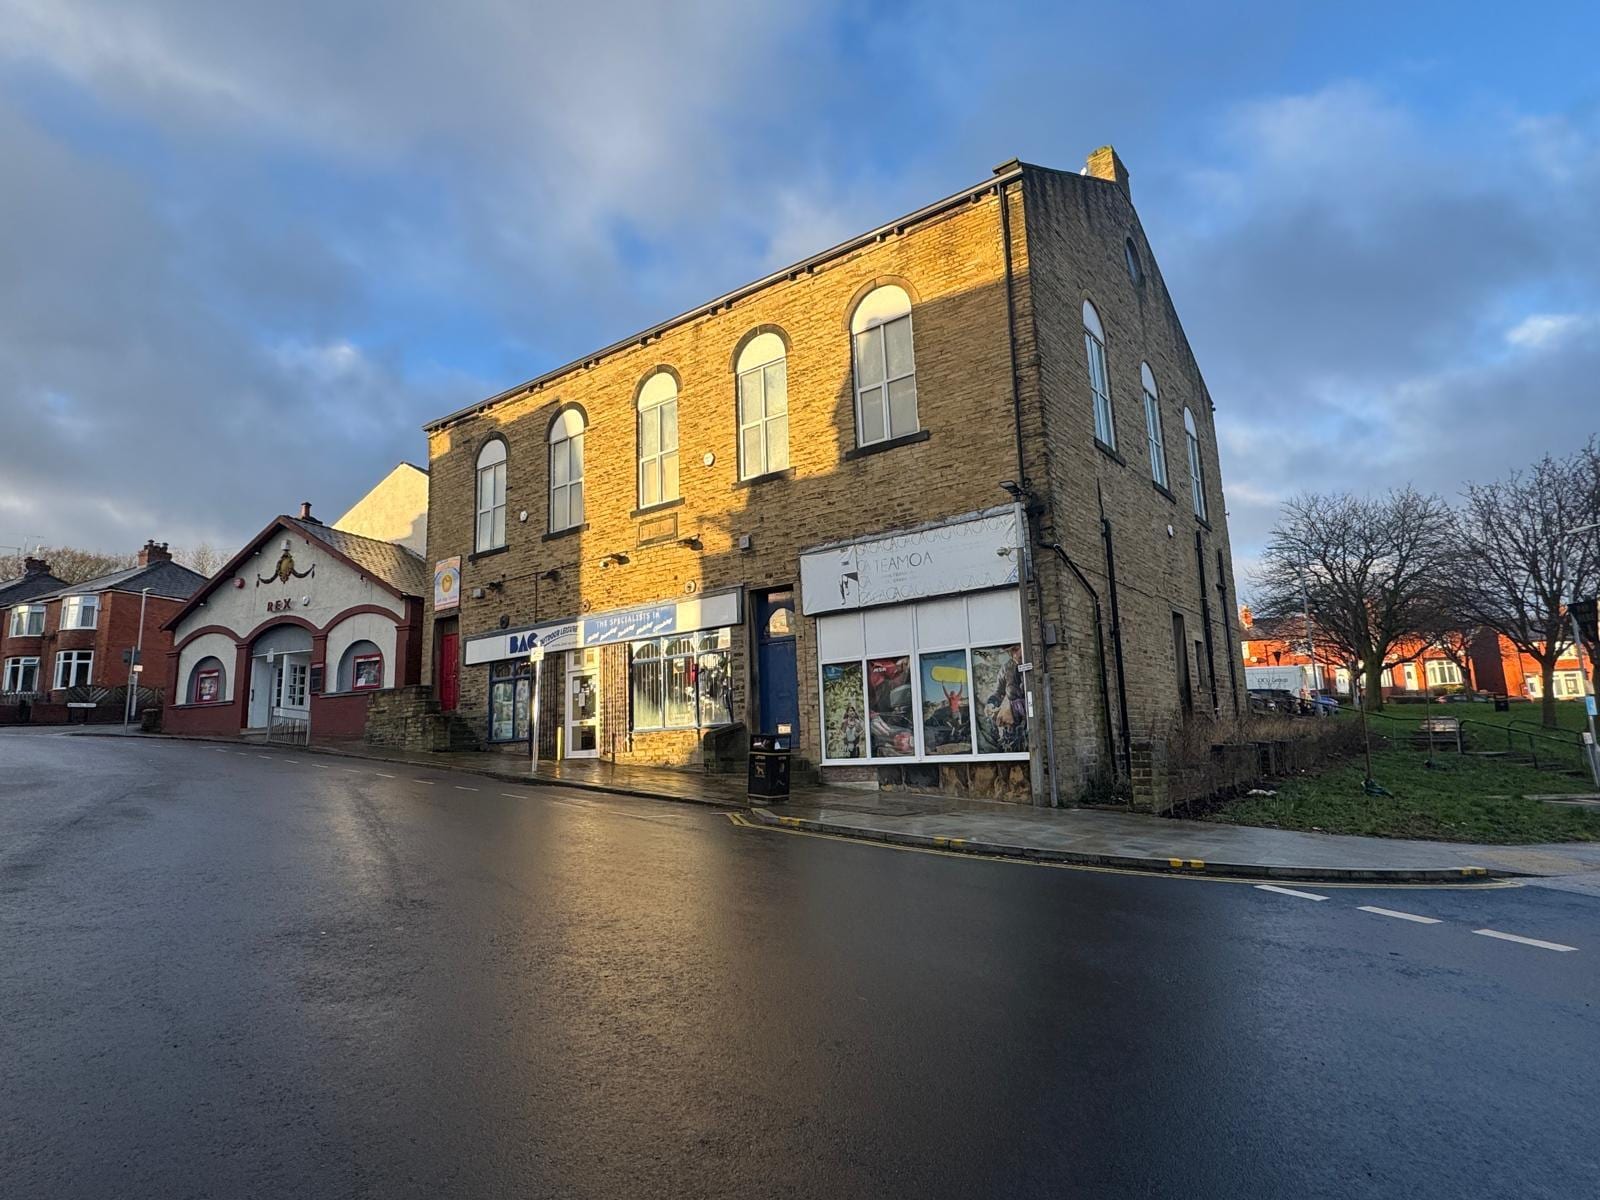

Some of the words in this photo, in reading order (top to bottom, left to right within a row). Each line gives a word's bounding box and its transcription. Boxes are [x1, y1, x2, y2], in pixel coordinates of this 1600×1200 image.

[874, 551, 933, 574] TEAMOA
[267, 598, 291, 612] REX
[596, 621, 608, 629] THE
[610, 610, 650, 626] SPECIALISTS
